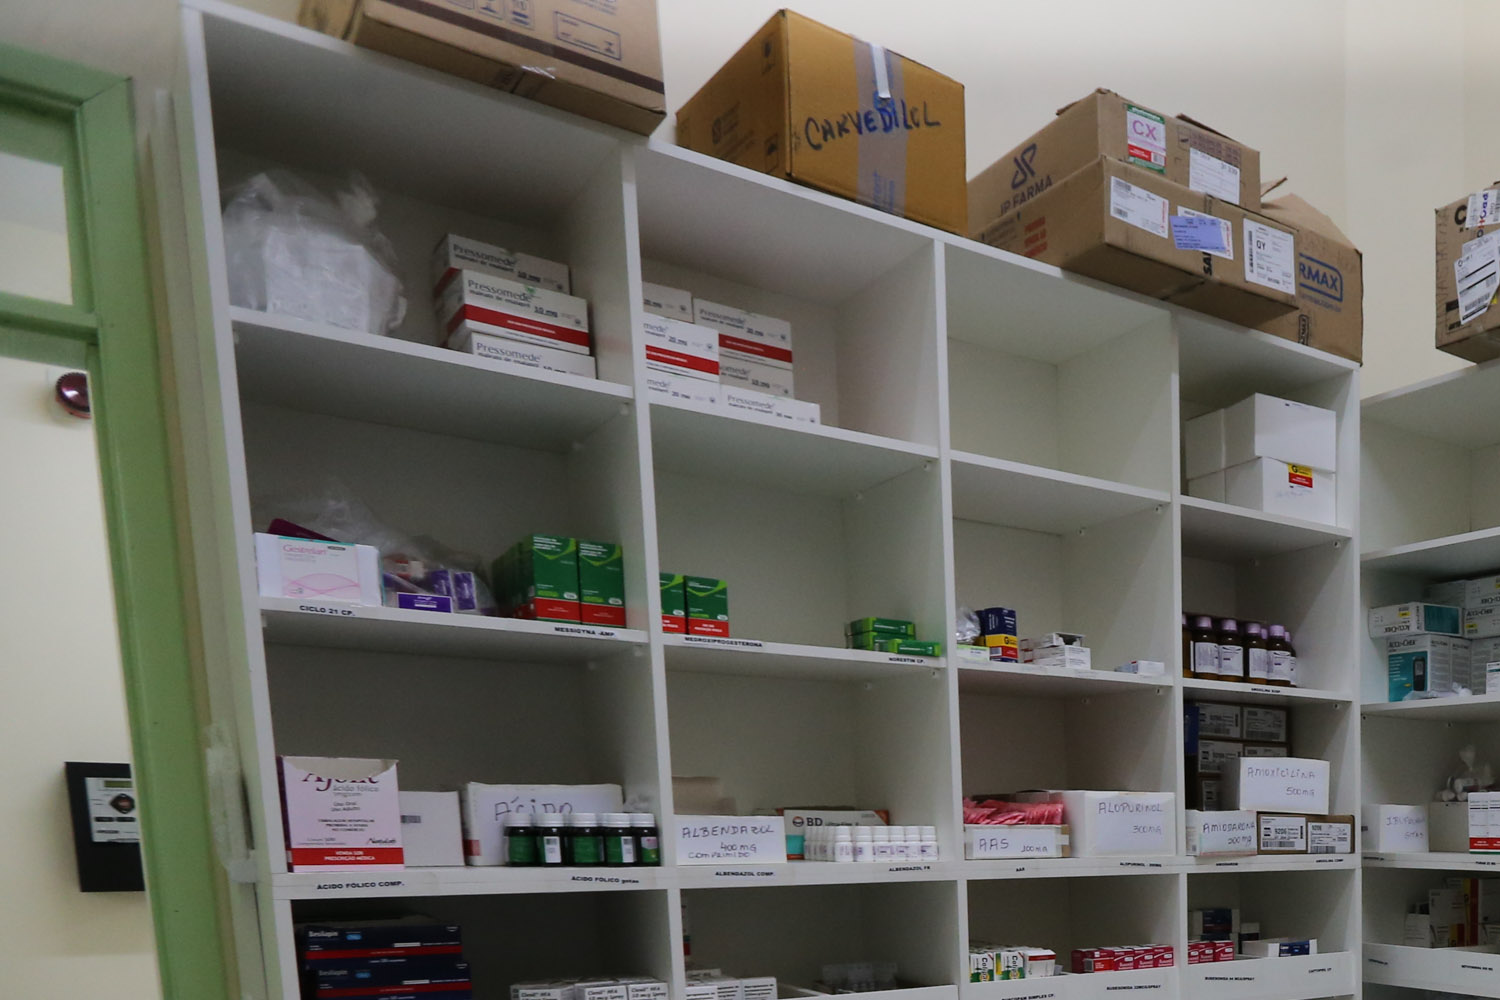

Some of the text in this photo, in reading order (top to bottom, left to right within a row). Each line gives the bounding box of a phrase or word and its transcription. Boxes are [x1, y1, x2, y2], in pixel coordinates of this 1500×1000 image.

[1013, 175, 1052, 208] FARMA
[1256, 240, 1266, 250] QY
[454, 244, 516, 266] Pressomede
[1299, 262, 1338, 292] RMAX
[468, 280, 532, 301] Pressomede
[476, 342, 541, 362] Pressomede
[300, 605, 326, 614] CICLO
[554, 626, 596, 636] MESSIGYNA
[806, 817, 823, 827] BD
[979, 838, 1010, 852] AAS
